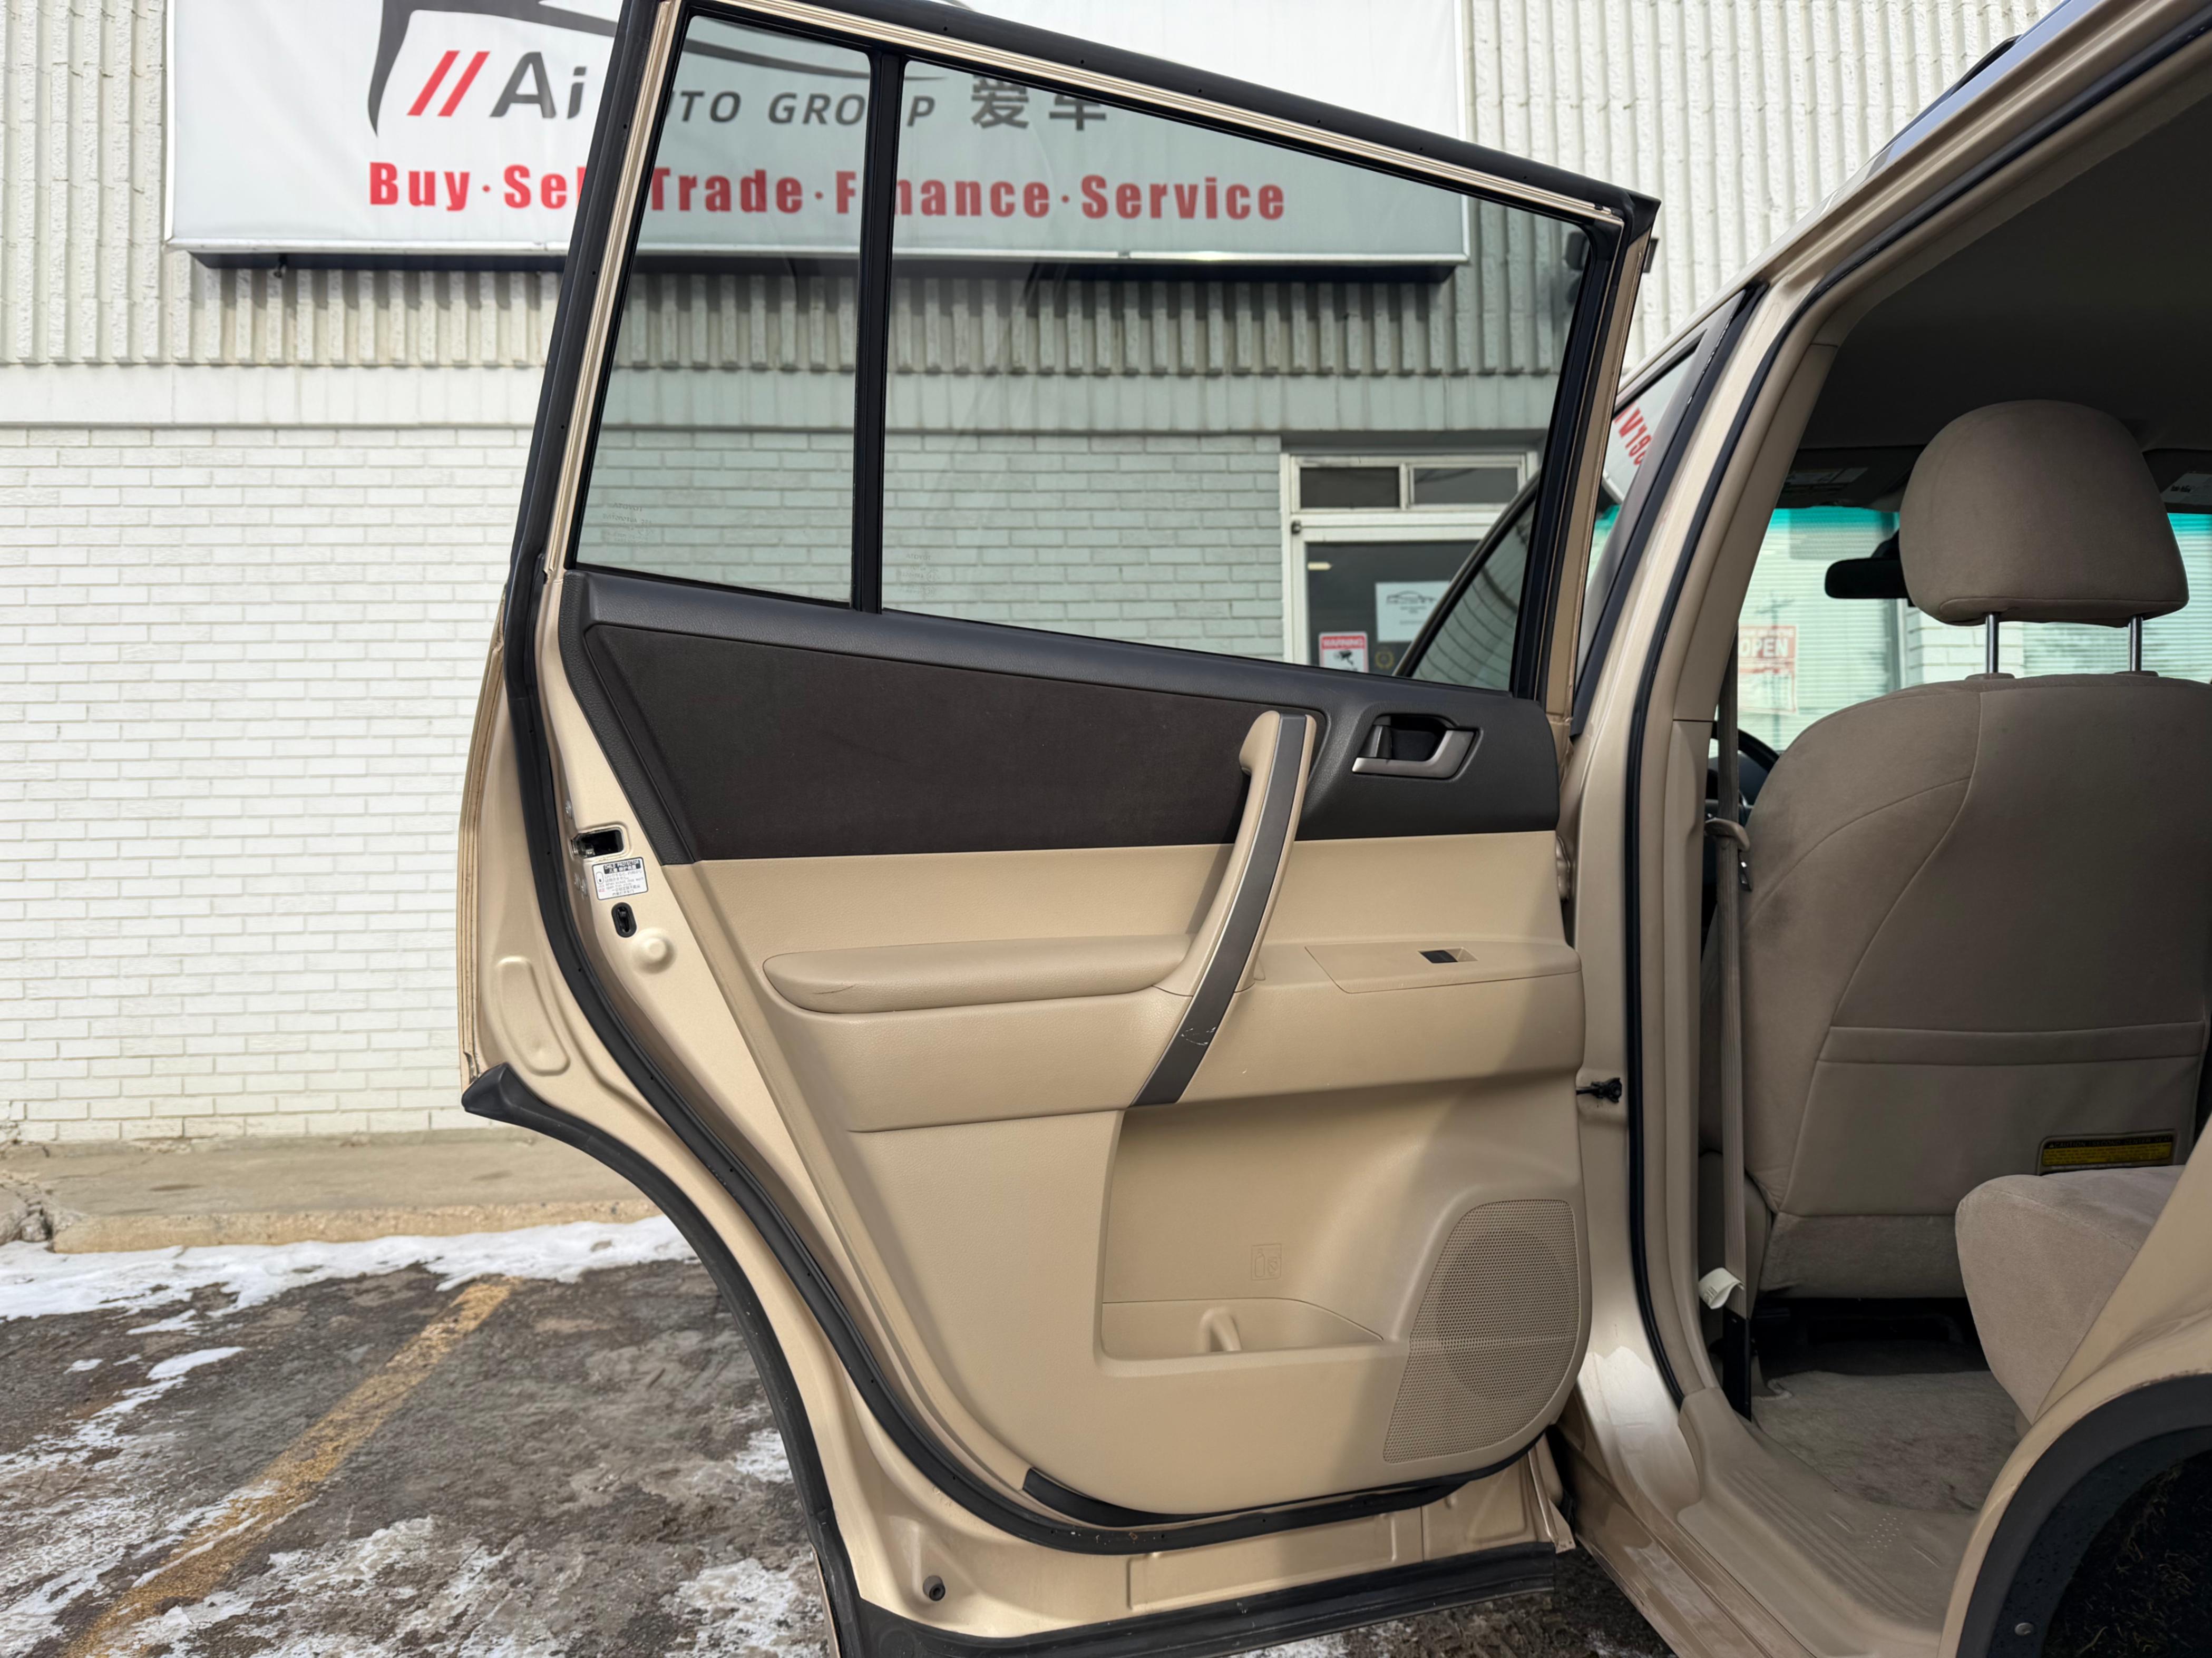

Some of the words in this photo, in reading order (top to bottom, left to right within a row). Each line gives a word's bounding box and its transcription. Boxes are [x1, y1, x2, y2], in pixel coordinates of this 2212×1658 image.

[489, 51, 587, 119] Ai
[666, 90, 742, 123] TO
[768, 92, 936, 127] GROP
[369, 162, 471, 211] Buy
[651, 167, 803, 214] Trade
[836, 171, 1049, 218] Fnance
[1081, 174, 1284, 220] Service
[1739, 637, 1788, 658] OPEN
